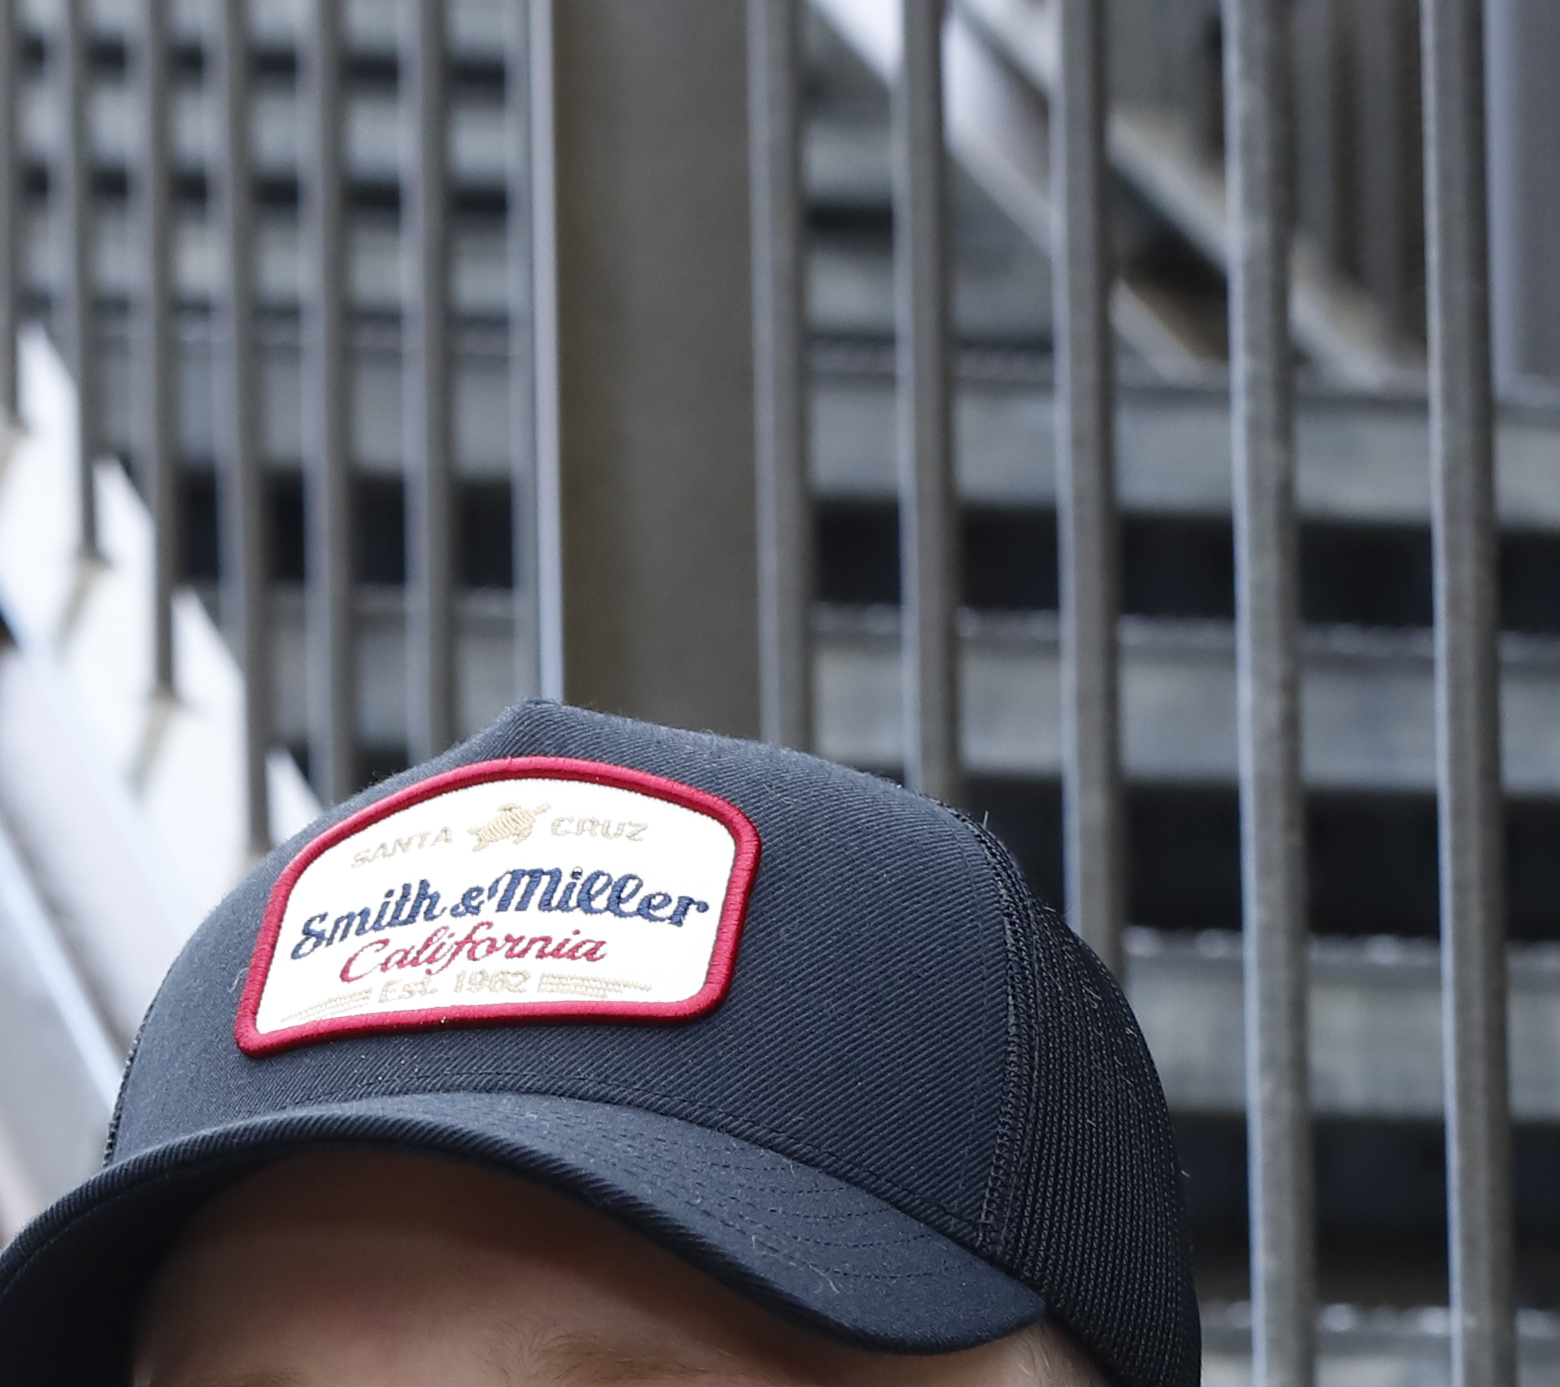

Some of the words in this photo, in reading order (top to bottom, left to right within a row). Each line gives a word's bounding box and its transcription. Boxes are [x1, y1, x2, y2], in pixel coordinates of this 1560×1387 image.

[351, 826, 453, 868] SANTA
[551, 817, 647, 842] CRUZ
[291, 879, 448, 960] Smith
[450, 887, 486, 917] &
[486, 866, 709, 927] Miller
[340, 922, 607, 983] California
[378, 973, 439, 1003] Est.
[455, 969, 532, 995] 1962
